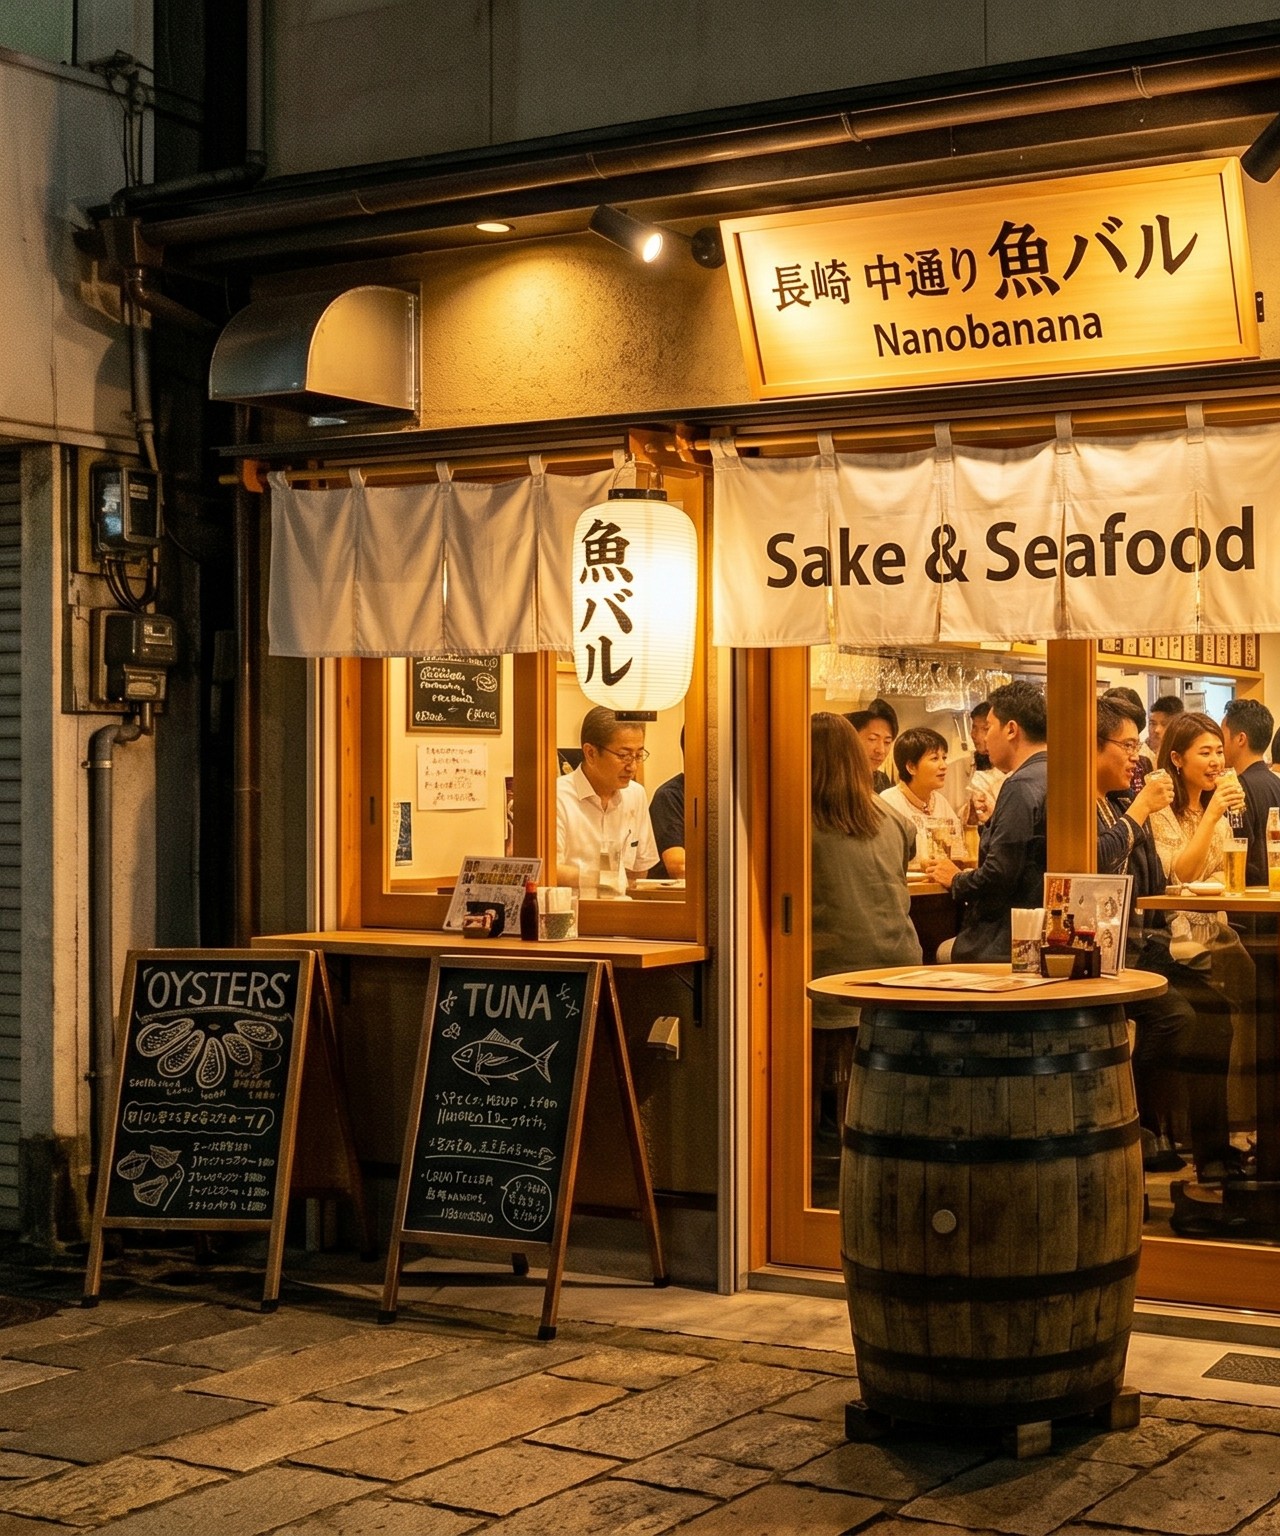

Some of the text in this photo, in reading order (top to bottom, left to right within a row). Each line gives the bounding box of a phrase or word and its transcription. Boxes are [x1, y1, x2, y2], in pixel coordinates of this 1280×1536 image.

[771, 213, 1199, 312] 長崎 中通り 魚バル
[873, 312, 1103, 358] Nanobanana
[766, 505, 1255, 588] Sake & Seafood
[578, 517, 634, 687] 魚バル
[147, 970, 291, 1009] OYSTERS
[463, 983, 552, 1021] TUNA
